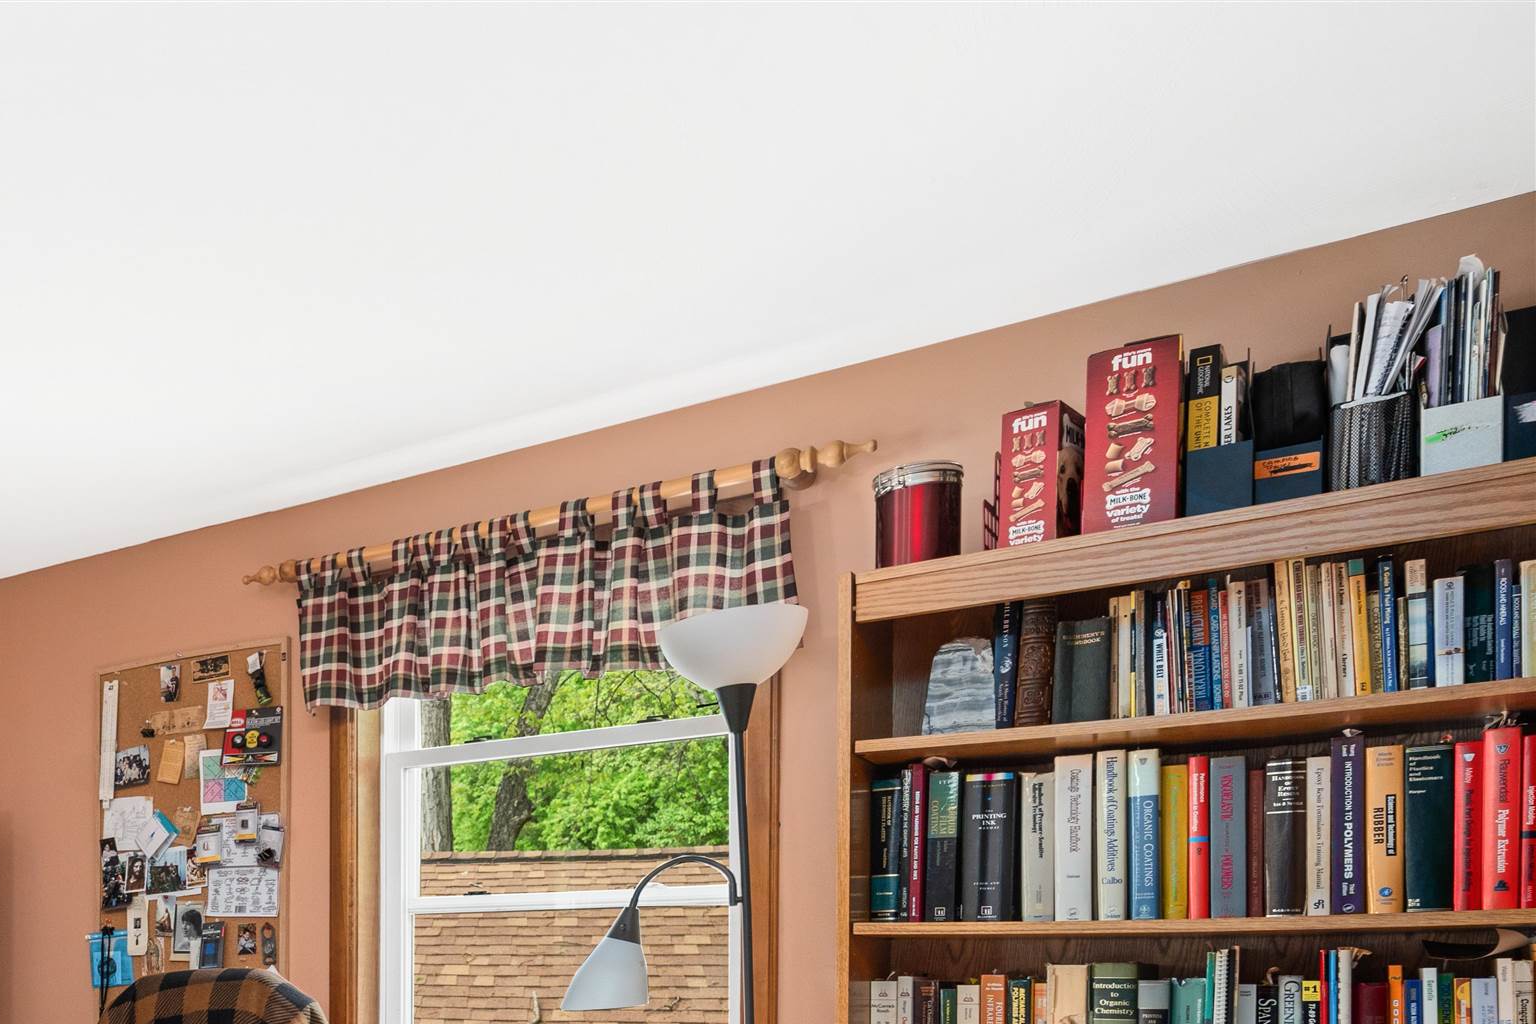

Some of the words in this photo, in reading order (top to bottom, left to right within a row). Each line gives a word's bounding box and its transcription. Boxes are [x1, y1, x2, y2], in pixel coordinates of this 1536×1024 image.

[1112, 352, 1153, 371] fun
[1012, 416, 1047, 433] fun
[1110, 493, 1146, 505] MILK-BONE
[1106, 504, 1150, 517] variety
[1012, 525, 1041, 536] MILK-BONE
[1009, 535, 1044, 546] variety
[1191, 594, 1204, 646] PREDICTABLY
[1384, 608, 1392, 624] Mixing
[1156, 643, 1164, 662] WHITE
[1156, 664, 1164, 679] BELT
[1194, 648, 1207, 699] IRRATIONAL
[1068, 769, 1082, 793] Coatings
[1106, 756, 1118, 795] Handbook
[1315, 767, 1325, 785] Epoxy
[1344, 761, 1353, 810] INTRODUCTION
[1526, 786, 1536, 804] Injection
[1068, 795, 1082, 824] Technology
[1106, 796, 1118, 804] of
[1387, 795, 1396, 814] Science
[931, 800, 939, 835] COATING
[972, 812, 1007, 820] PRINTING
[1104, 804, 1118, 836] Coatings
[1143, 800, 1154, 840] ORGANIC
[1344, 811, 1353, 821] TO
[1387, 815, 1396, 823] and
[1495, 810, 1510, 837] Polymer
[1526, 805, 1536, 825] Molding
[1373, 807, 1384, 844] RUBBER
[1070, 826, 1081, 853] Handbook
[1387, 824, 1396, 849] Technology
[1106, 837, 1118, 872] Additives
[1315, 842, 1325, 866] Training
[1344, 822, 1353, 879] POLYMERS
[1497, 839, 1509, 873] Extrusion
[1143, 843, 1154, 887] COATINGS
[1316, 867, 1324, 890] Manual
[1304, 985, 1318, 993] #1
[1095, 1007, 1134, 1016] Chemistry
[1099, 999, 1129, 1008] Organic
[1307, 1003, 1316, 1017] TI-89
